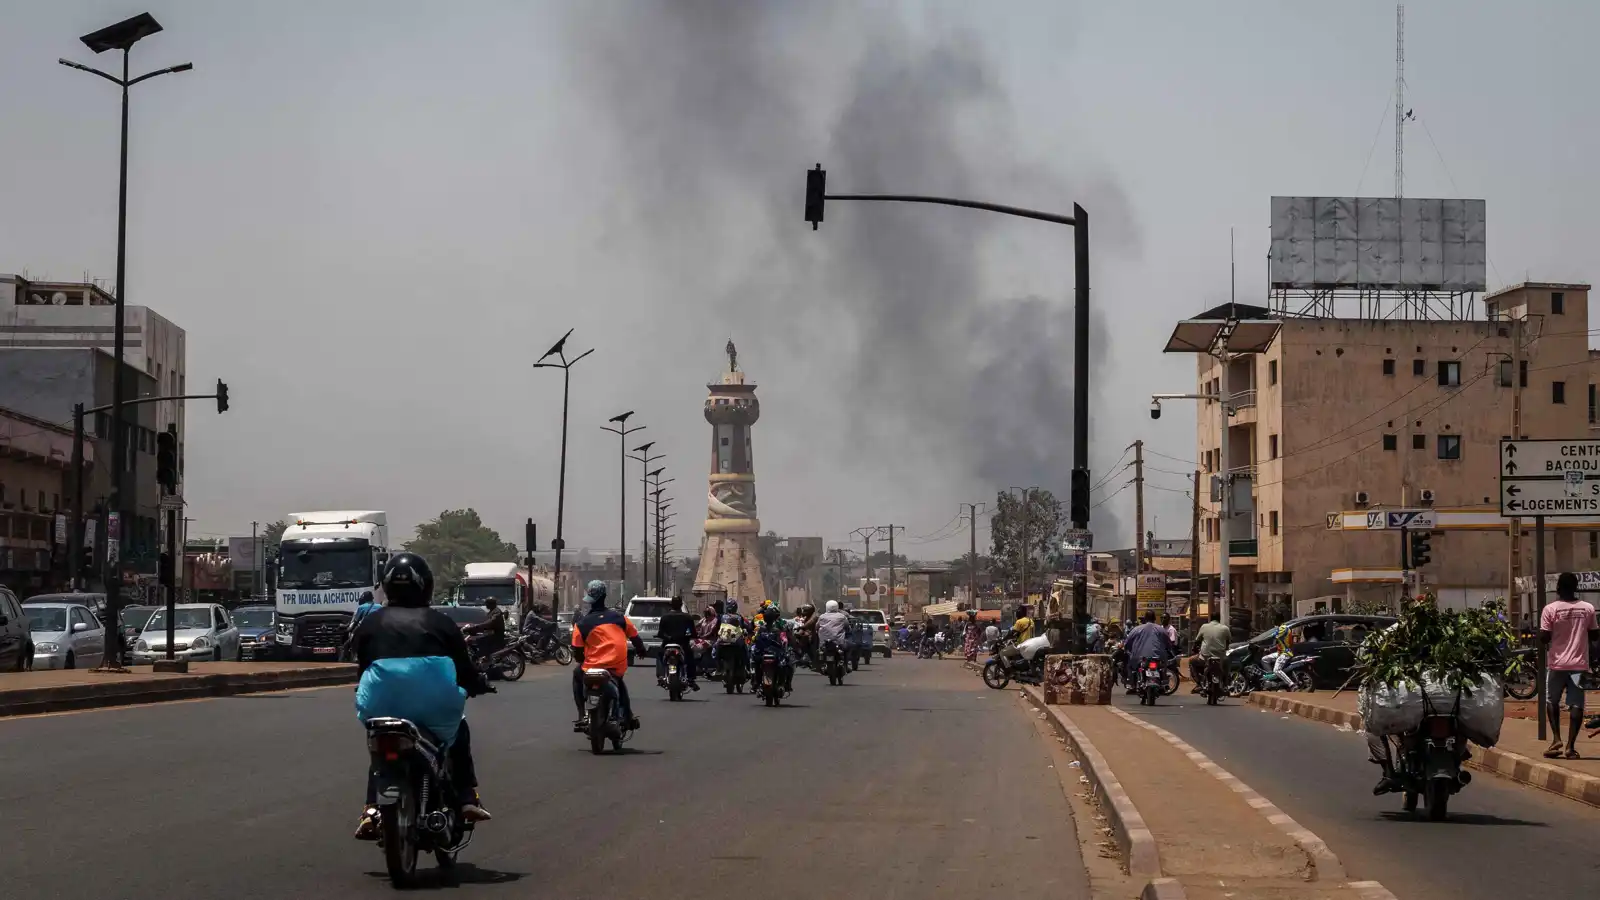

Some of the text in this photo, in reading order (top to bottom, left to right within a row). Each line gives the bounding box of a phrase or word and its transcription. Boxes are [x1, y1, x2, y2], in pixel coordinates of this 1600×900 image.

[1546, 460, 1598, 471] BACODJ
[1522, 500, 1598, 510] LOGEMENTS
[283, 591, 360, 604] TPR MAIGA AICHATOU
